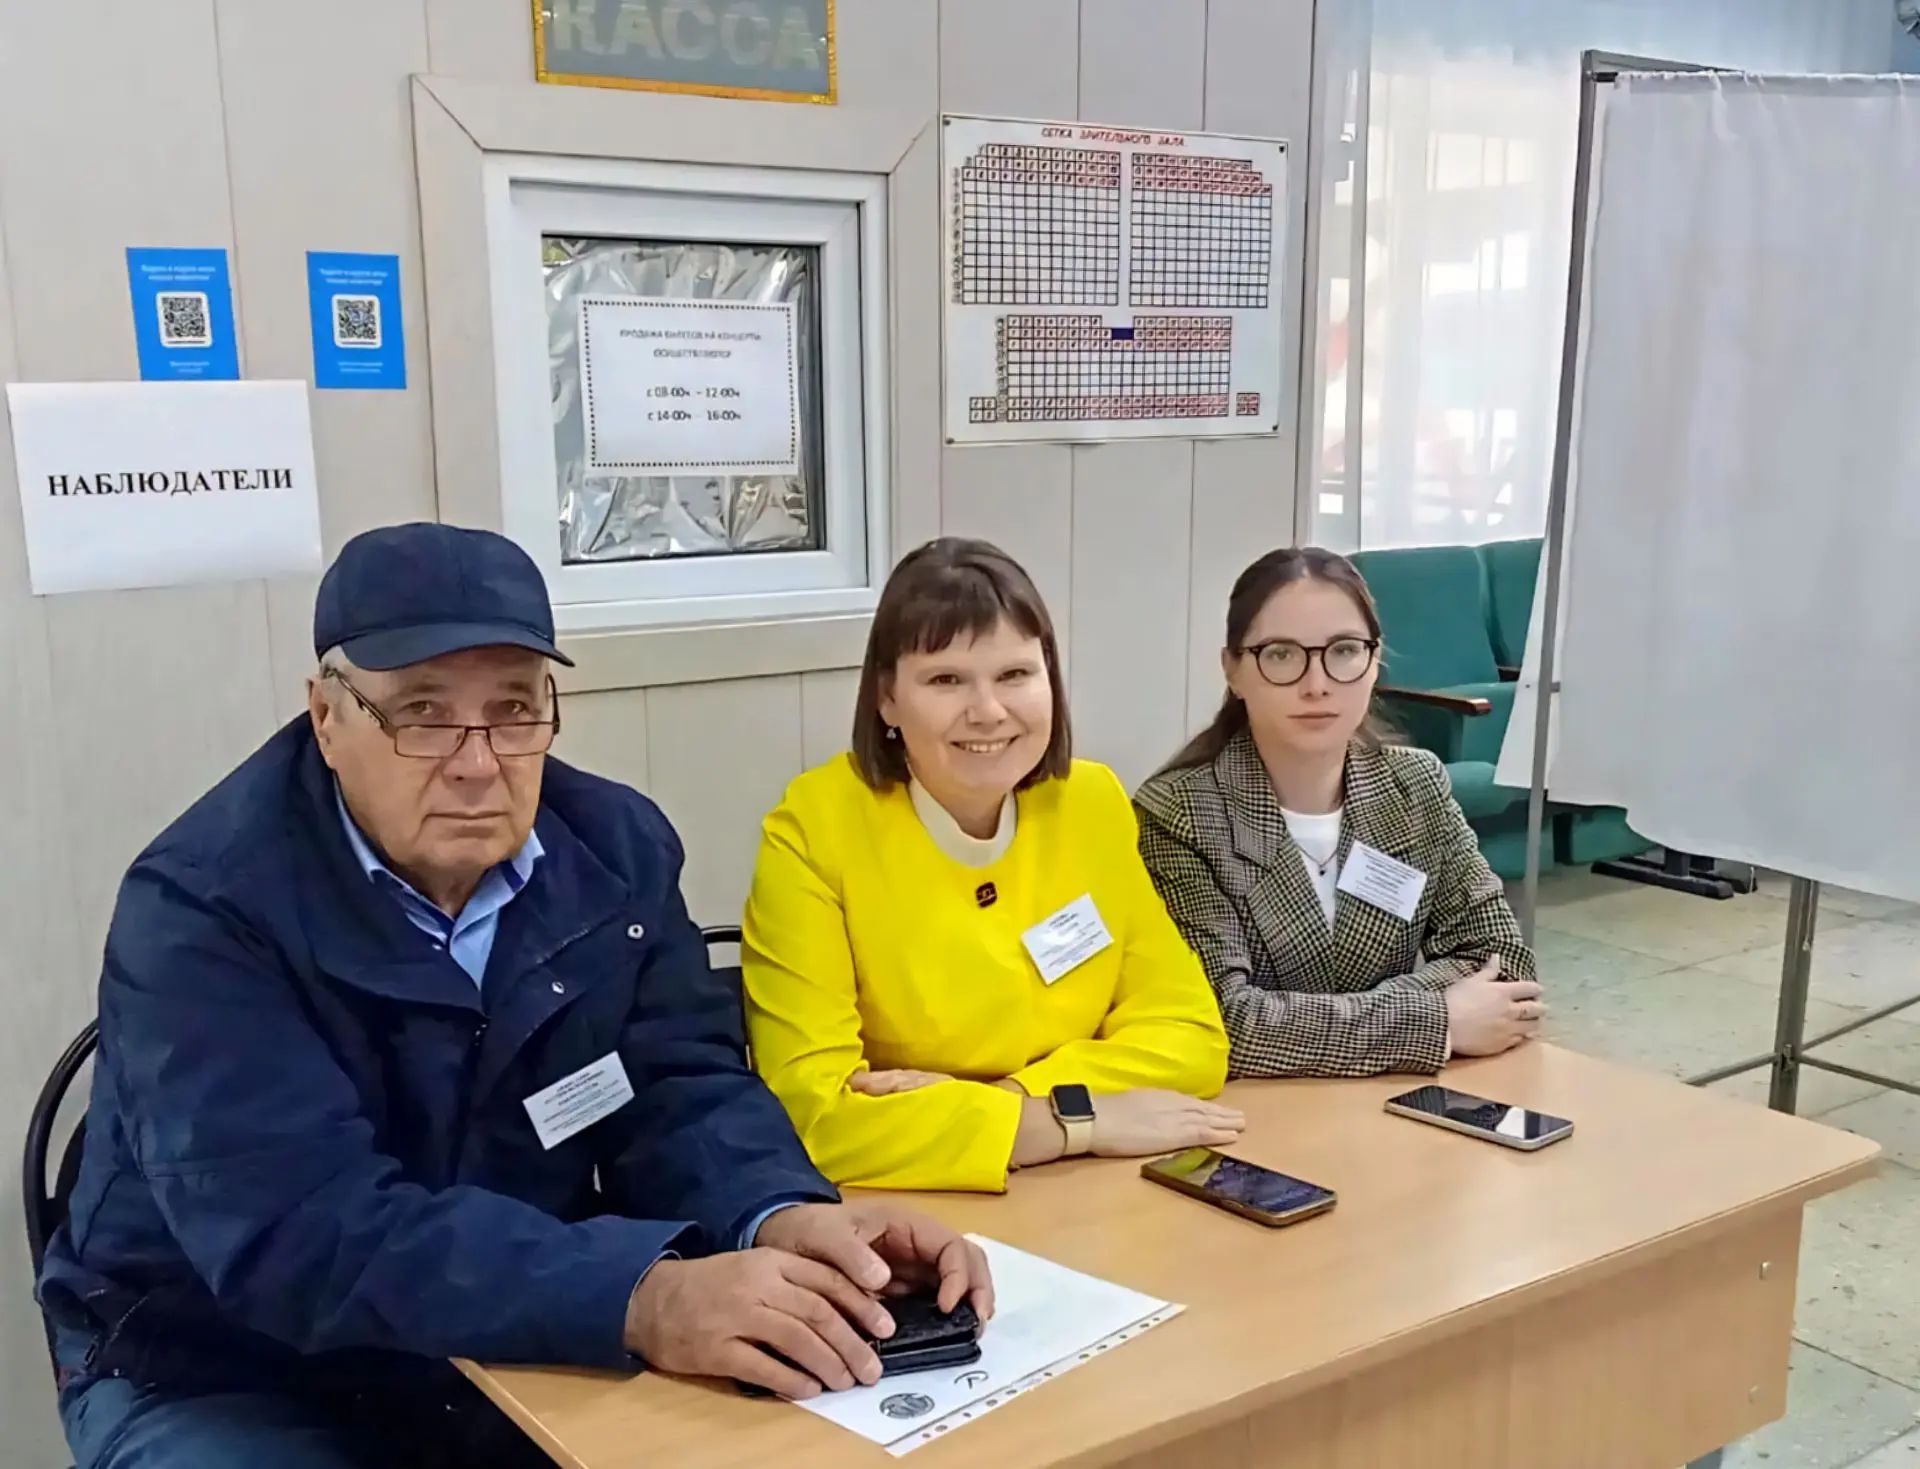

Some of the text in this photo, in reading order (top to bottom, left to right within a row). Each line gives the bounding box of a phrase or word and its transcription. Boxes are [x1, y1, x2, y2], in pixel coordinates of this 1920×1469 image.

[551, 0, 821, 69] КАССА
[1041, 127, 1073, 139] СЕТКА
[48, 468, 294, 496] НАБЛЮДАТЕЛИ
